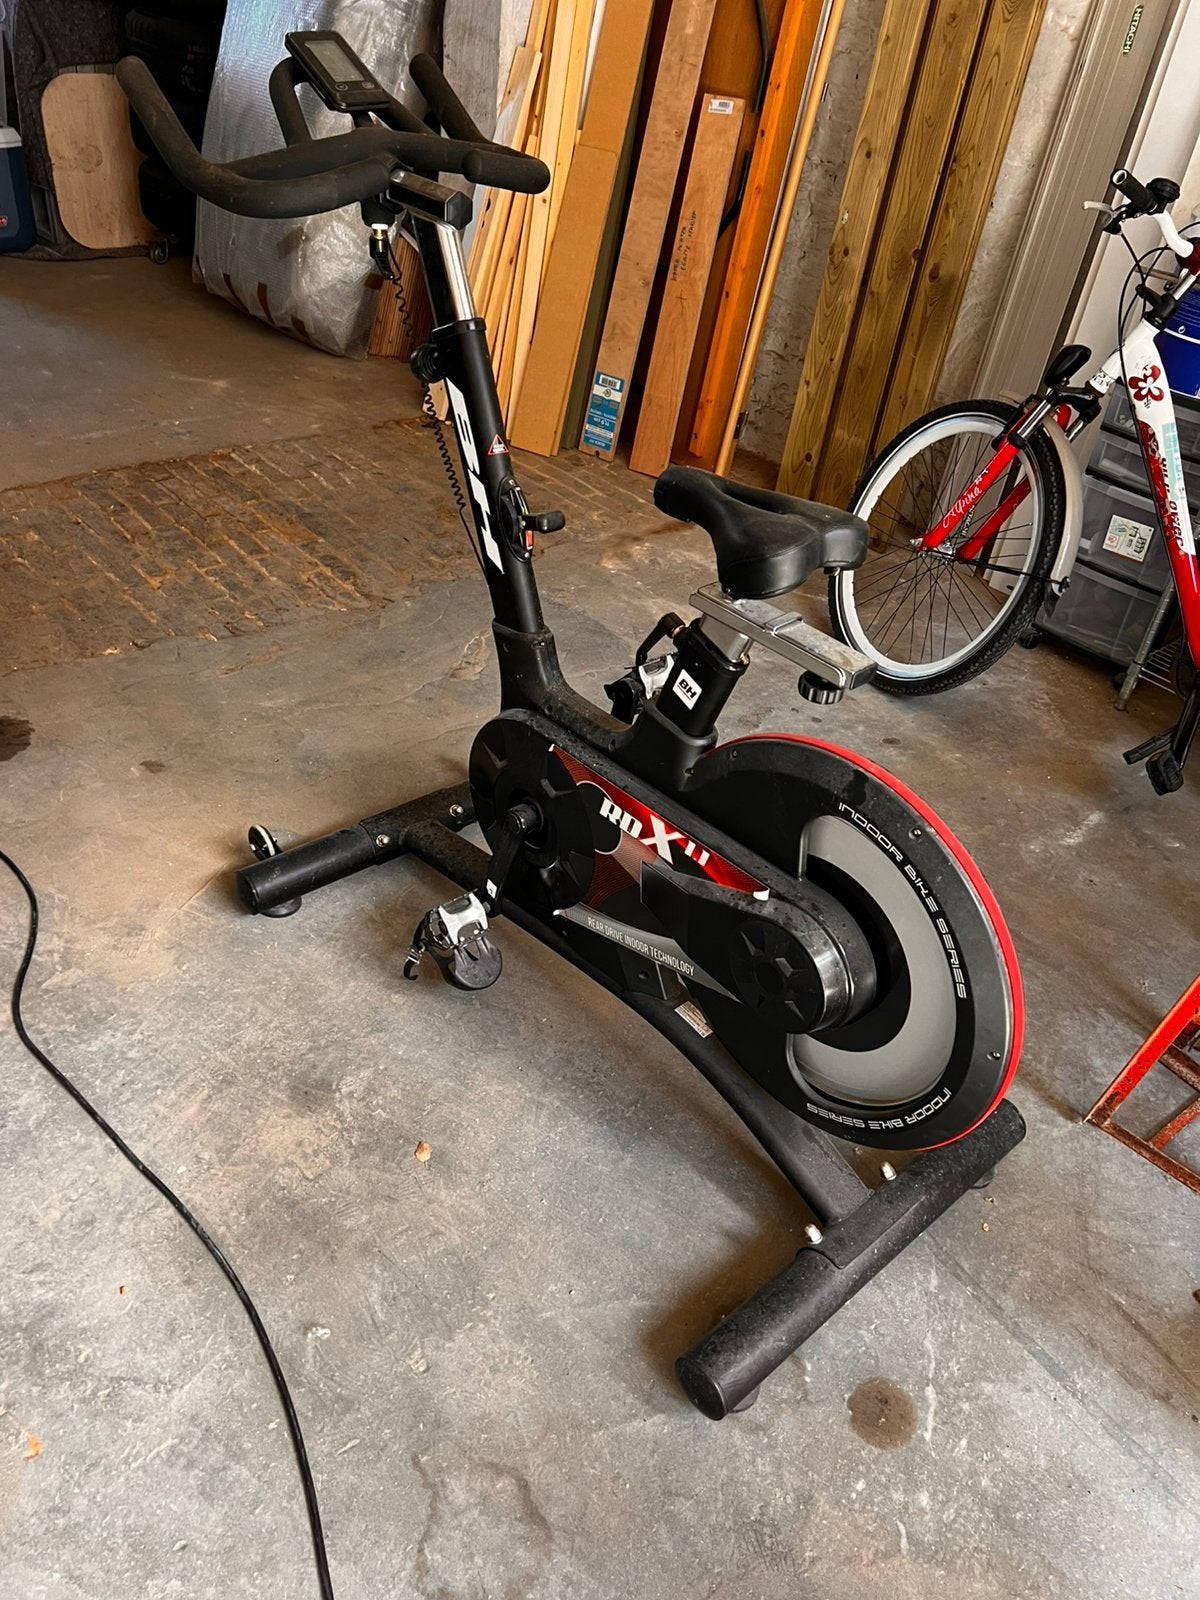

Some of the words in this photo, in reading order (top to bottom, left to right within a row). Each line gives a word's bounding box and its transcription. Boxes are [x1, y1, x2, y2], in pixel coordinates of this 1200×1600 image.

[1122, 8, 1143, 53] HITACHI
[446, 377, 505, 575] BH
[679, 678, 697, 699] BH
[838, 802, 904, 863] INDOOR
[904, 864, 939, 913] BIKE
[936, 918, 967, 999] SERIES
[587, 916, 605, 934] REAR
[604, 925, 624, 943] DRIVE
[624, 934, 649, 955] INDOOR
[649, 945, 695, 976] TECHNOLOGY
[806, 1102, 866, 1128] SERIES
[867, 1118, 905, 1130] BIKE
[904, 1087, 953, 1125] INDOOR
